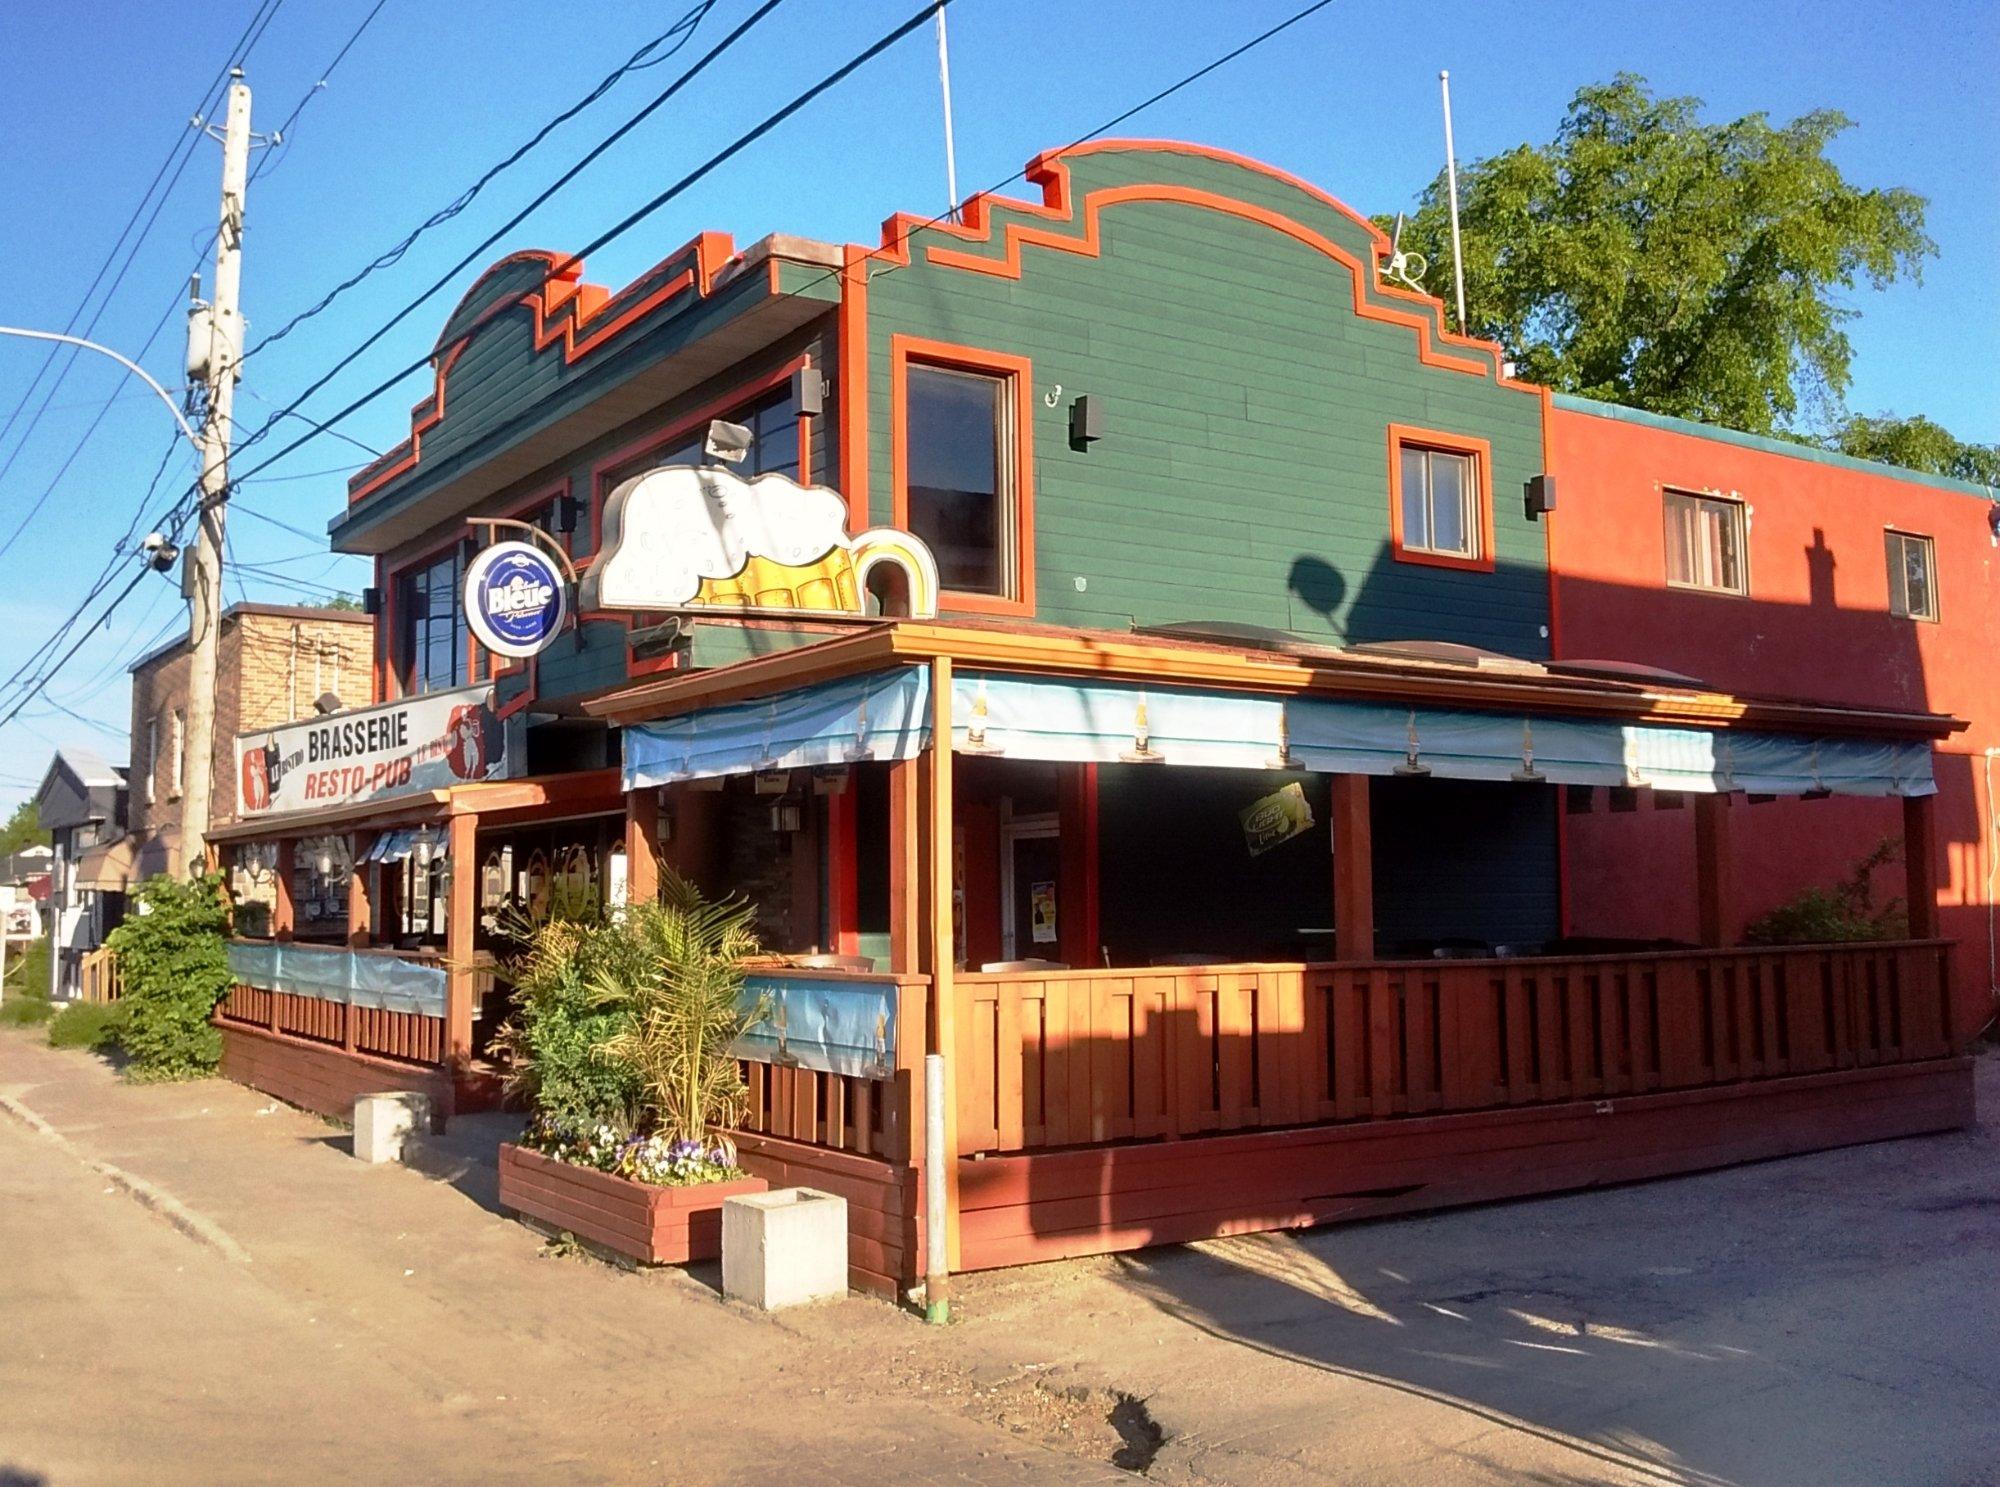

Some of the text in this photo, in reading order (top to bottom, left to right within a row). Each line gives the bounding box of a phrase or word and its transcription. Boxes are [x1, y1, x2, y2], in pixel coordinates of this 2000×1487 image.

[488, 585, 553, 614] Bleue
[309, 711, 408, 763] BRASSERIE
[304, 755, 412, 800] RESTO-PUB
